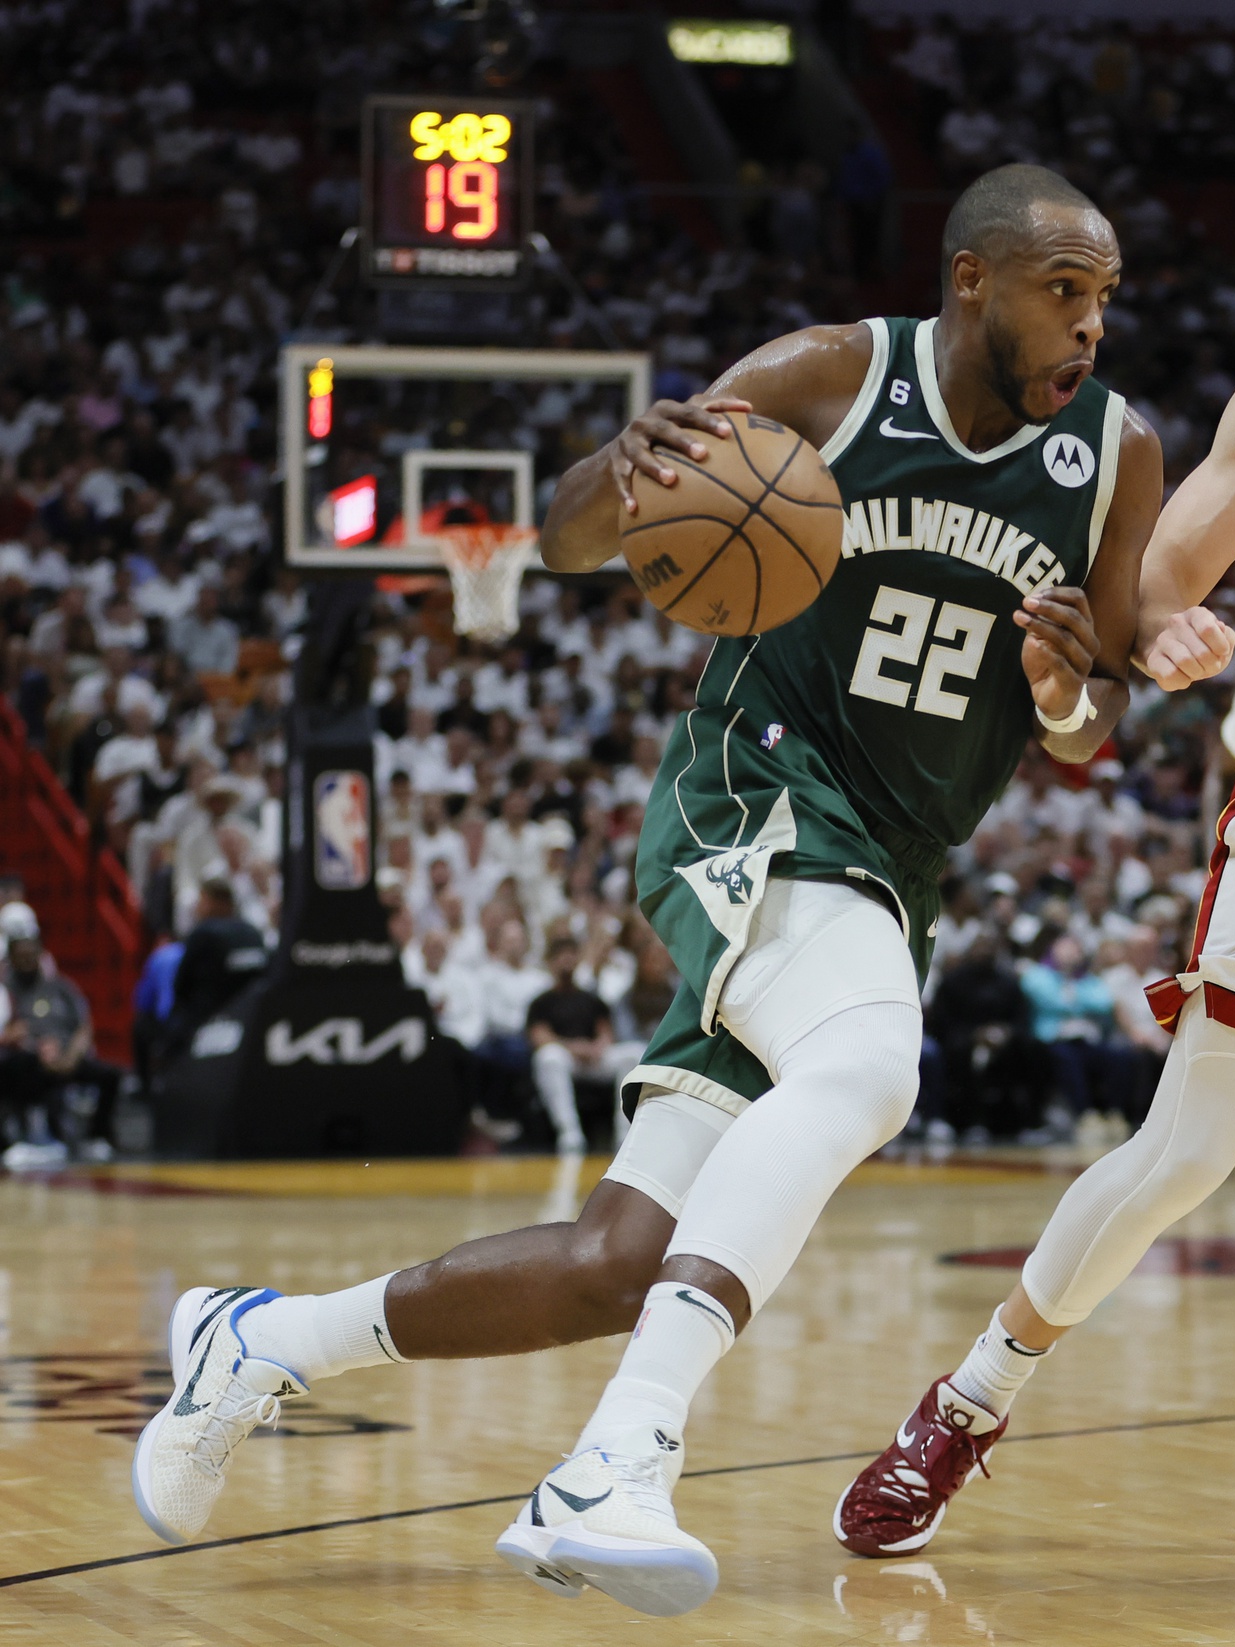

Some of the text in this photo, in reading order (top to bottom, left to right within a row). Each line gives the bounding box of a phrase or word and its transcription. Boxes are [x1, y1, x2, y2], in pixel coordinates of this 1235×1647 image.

[410, 112, 511, 162] 5:02
[426, 161, 498, 239] 19
[889, 378, 911, 406] 6
[848, 584, 997, 721] 22
